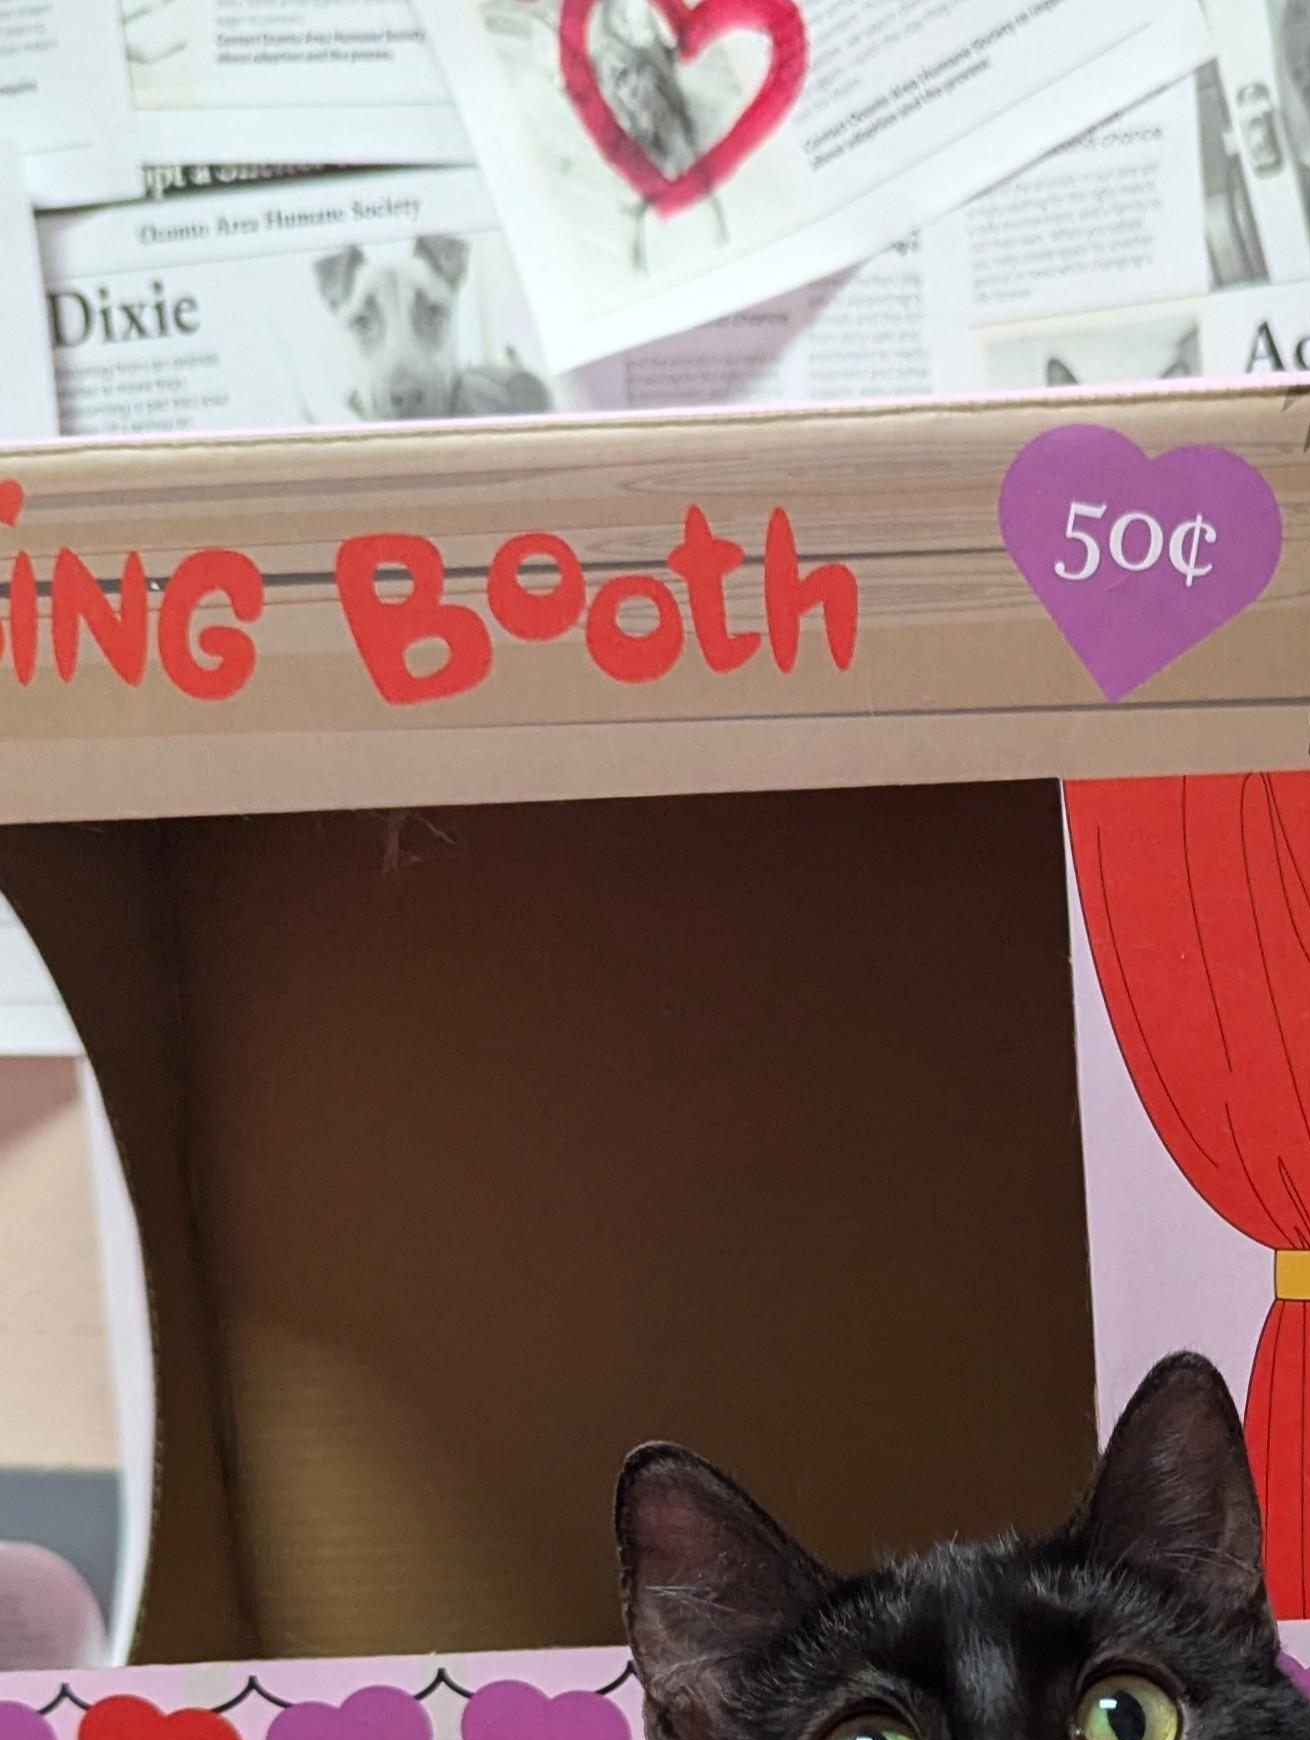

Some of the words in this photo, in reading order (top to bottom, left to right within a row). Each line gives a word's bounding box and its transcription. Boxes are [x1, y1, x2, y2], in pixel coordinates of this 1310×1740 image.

[50, 282, 200, 349] Dixie
[1055, 502, 1216, 587] 50¢
[0, 480, 264, 700] ING
